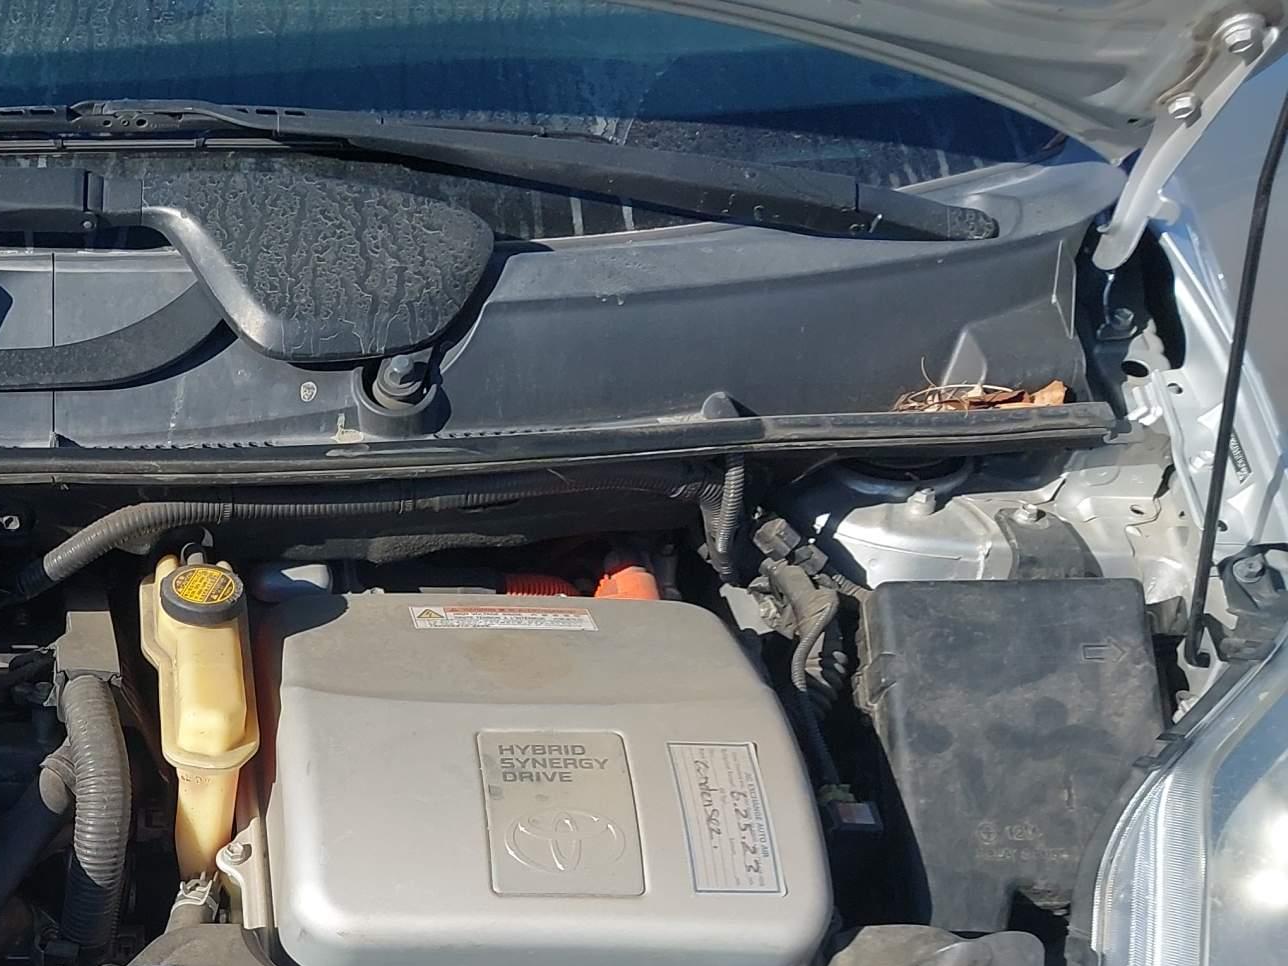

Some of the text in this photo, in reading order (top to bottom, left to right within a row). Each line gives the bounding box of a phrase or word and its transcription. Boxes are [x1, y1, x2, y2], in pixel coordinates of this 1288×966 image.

[498, 745, 586, 755] HYBRID
[501, 758, 609, 770] SYNERGY
[502, 771, 573, 782] DRIVE
[756, 822, 767, 843] AUTO
